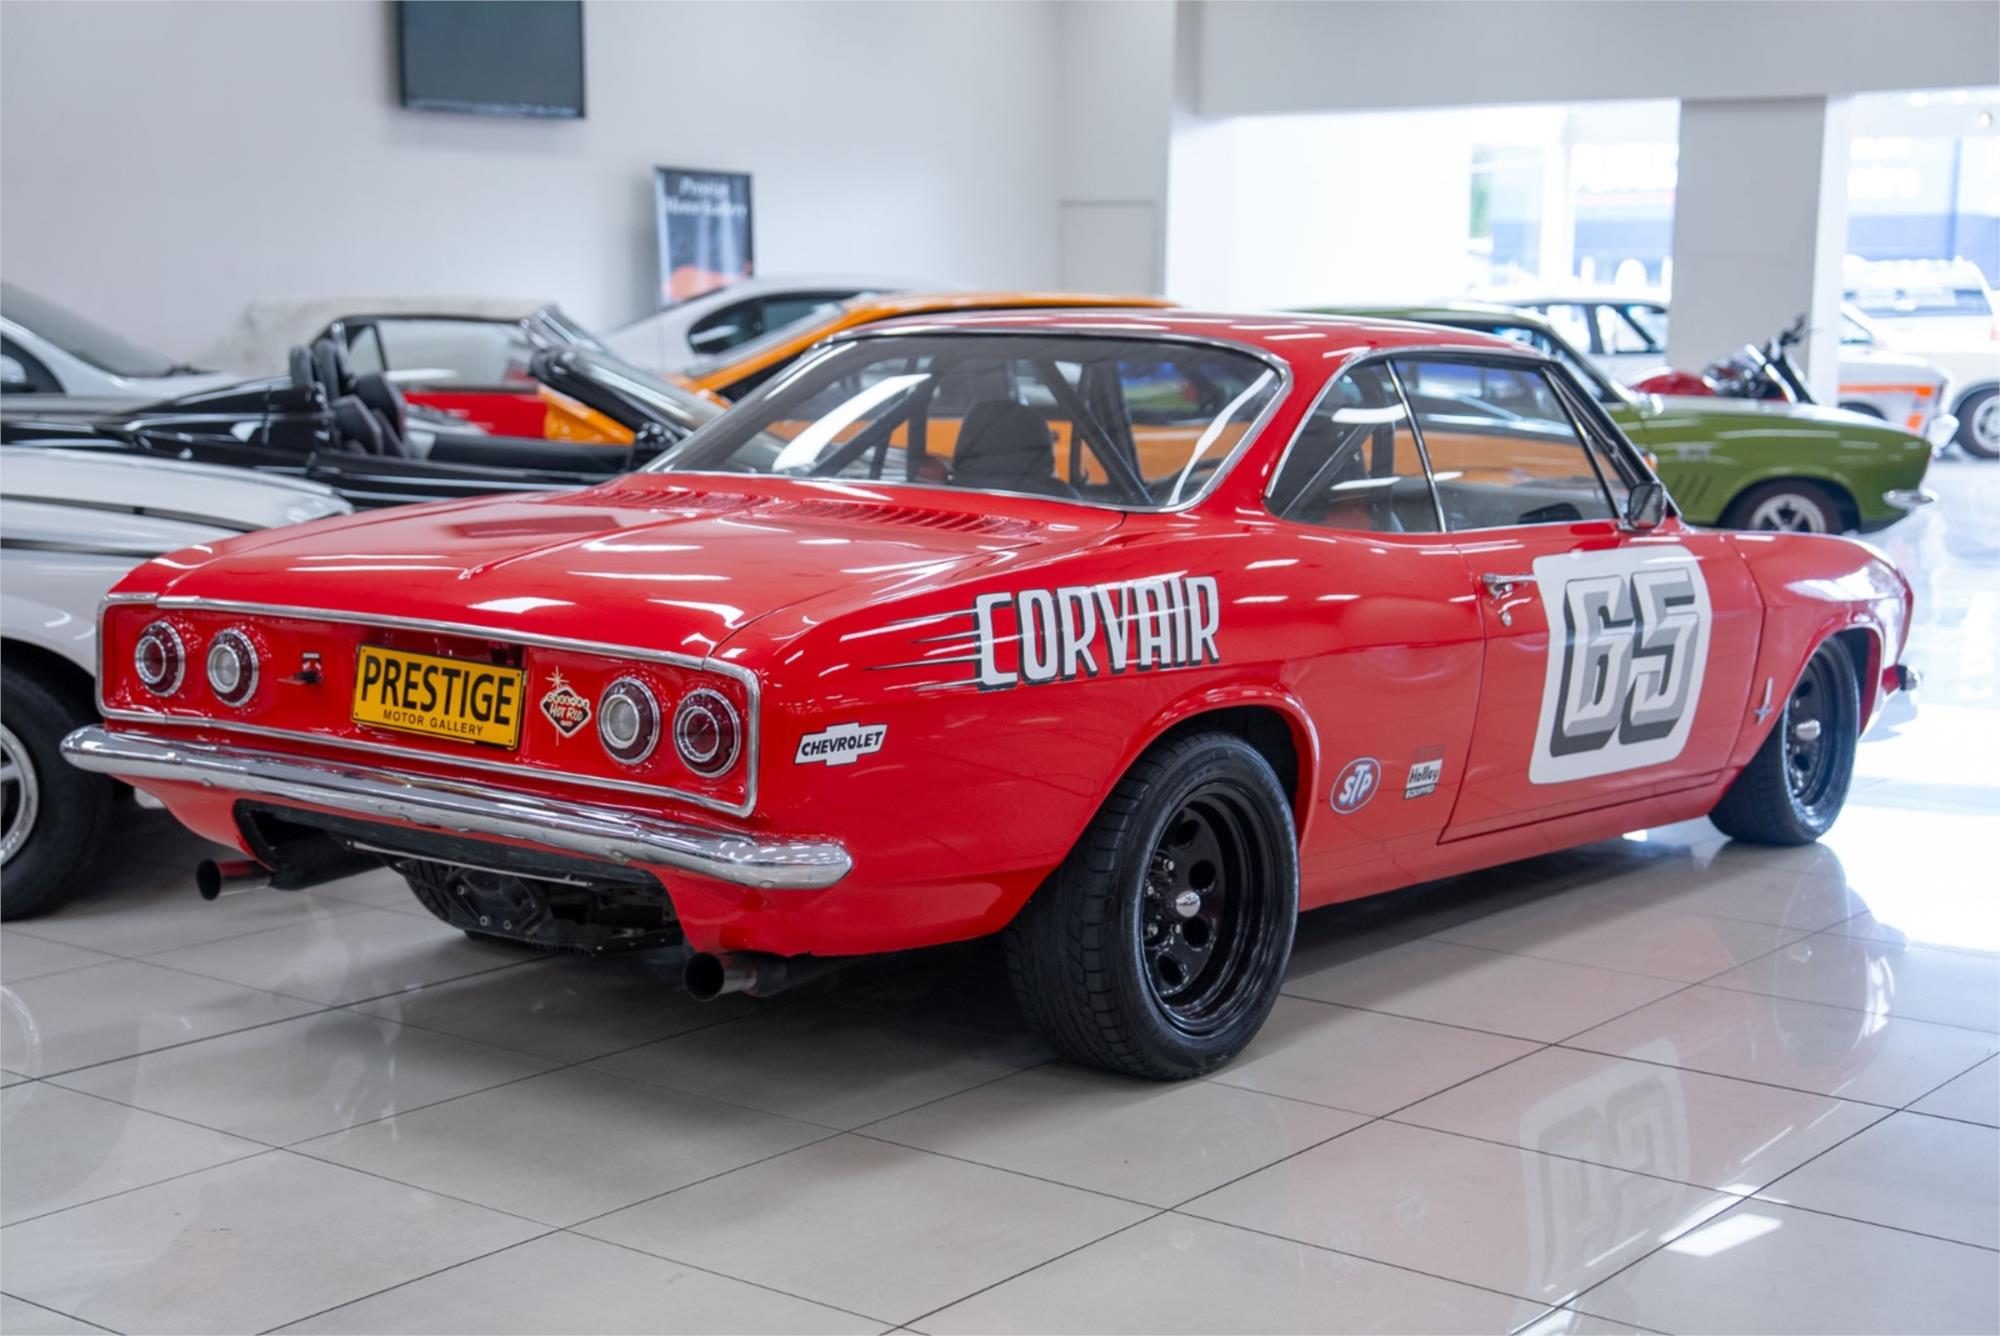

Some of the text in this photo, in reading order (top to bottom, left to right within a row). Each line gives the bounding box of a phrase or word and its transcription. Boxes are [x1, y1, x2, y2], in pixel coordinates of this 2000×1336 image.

[975, 576, 1220, 691] CORVAIR
[1550, 567, 1700, 757] 65
[361, 655, 515, 725] PRESTIGE
[383, 709, 485, 737] MOTOR GALLERY
[801, 730, 884, 757] CHEVROLET
[1339, 765, 1372, 805] STP
[1408, 765, 1440, 783] Holley
